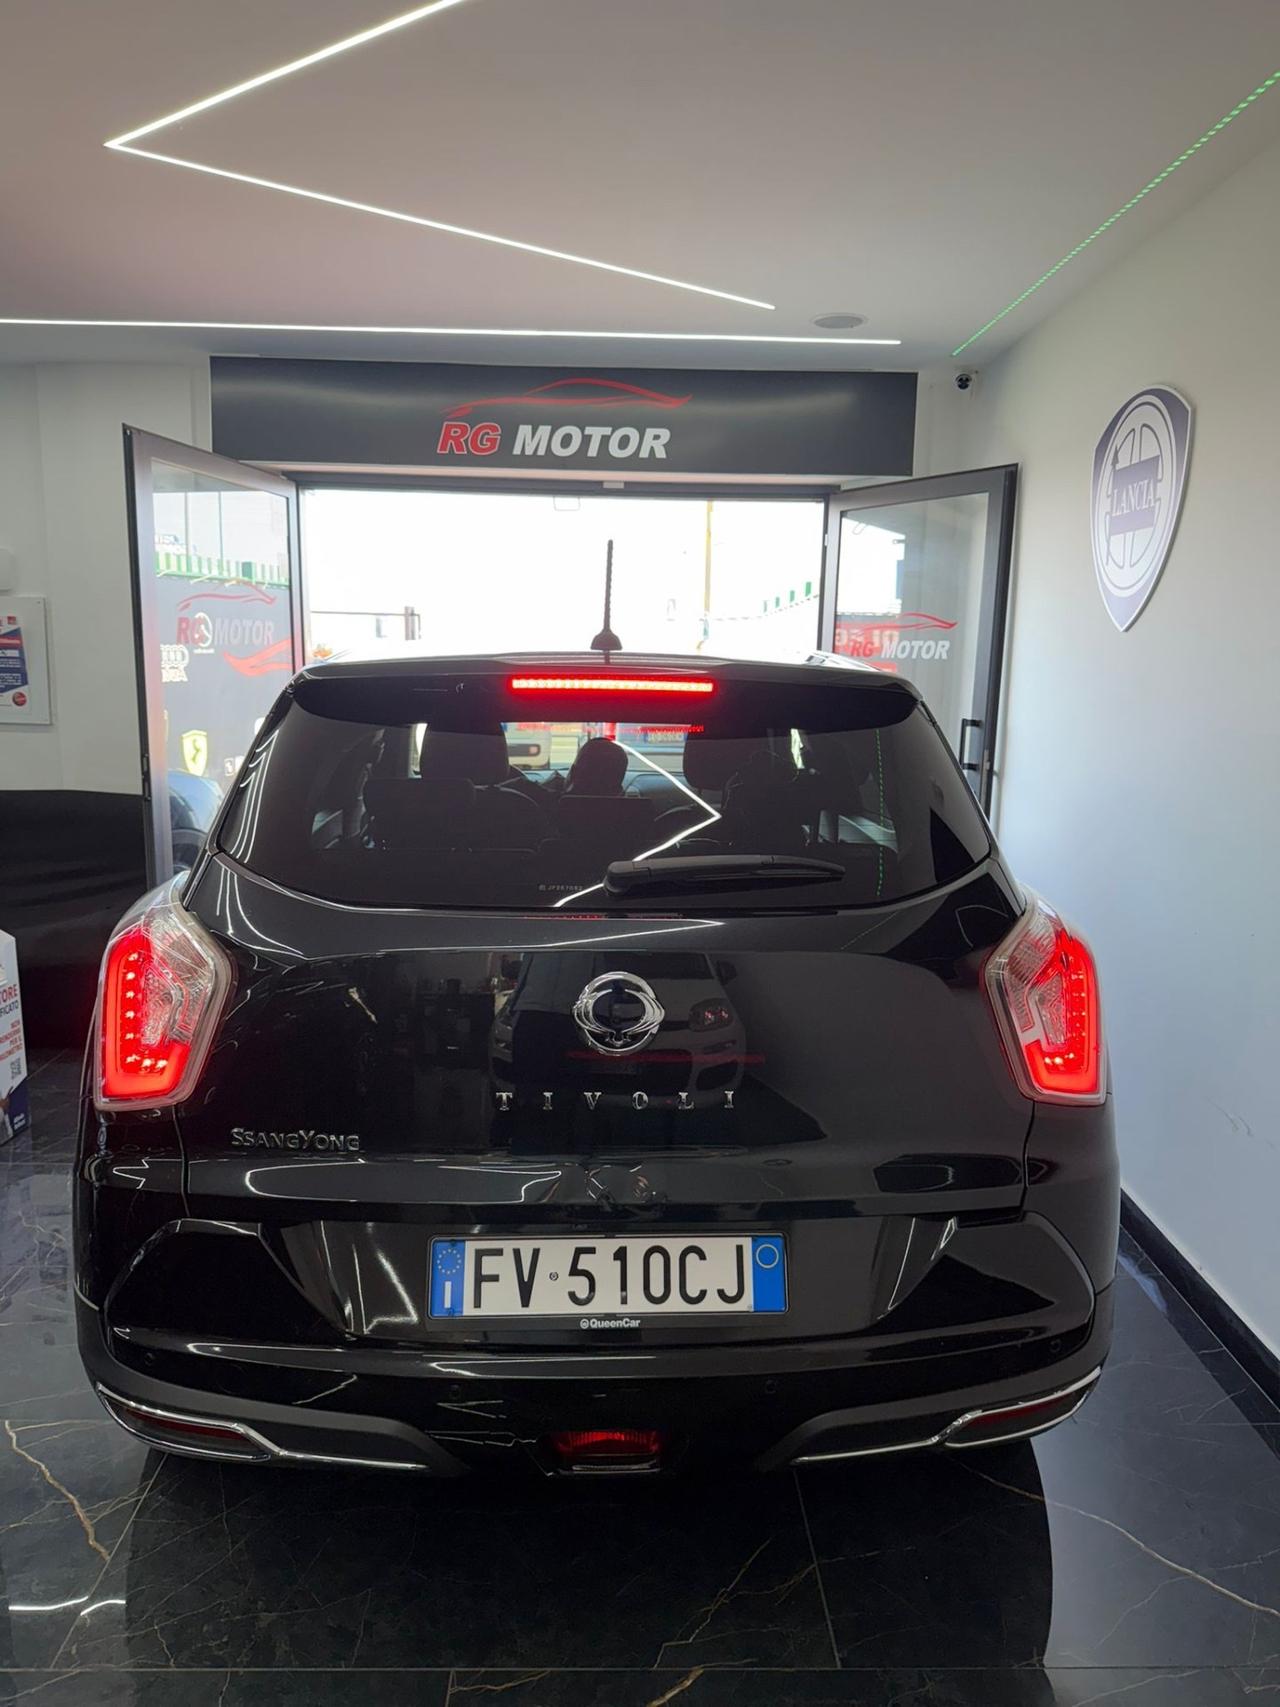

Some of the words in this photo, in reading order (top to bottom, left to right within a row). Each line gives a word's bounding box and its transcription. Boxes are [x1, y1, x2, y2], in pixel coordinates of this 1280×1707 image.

[437, 421, 501, 455] RG
[512, 424, 671, 459] MOTOR
[1112, 478, 1156, 516] LANCIA
[213, 618, 275, 646] MOTOR
[849, 640, 875, 658] RG
[880, 640, 951, 660] MOTOR
[496, 1091, 735, 1111] TIVOLI
